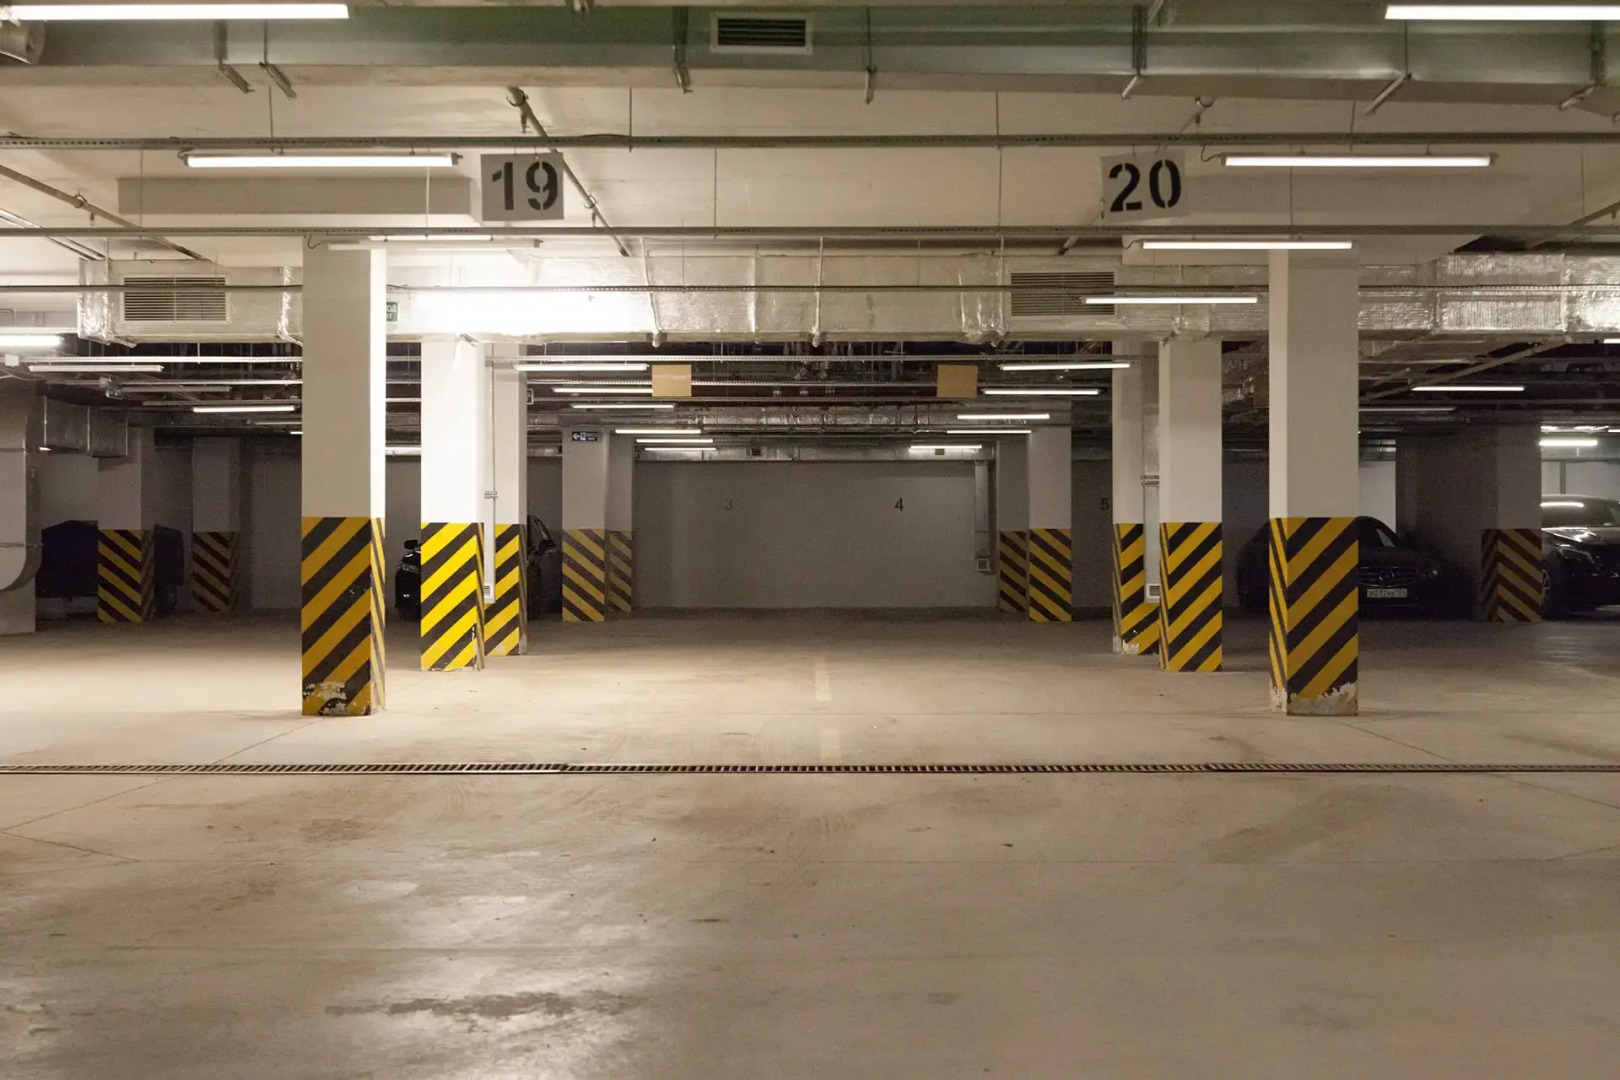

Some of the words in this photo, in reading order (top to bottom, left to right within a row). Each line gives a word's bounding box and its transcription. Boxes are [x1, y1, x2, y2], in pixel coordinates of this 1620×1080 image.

[492, 161, 558, 211] 19
[1108, 159, 1182, 213] 20
[724, 498, 734, 512] 3
[894, 496, 905, 512] 4
[1100, 497, 1110, 511] 5
